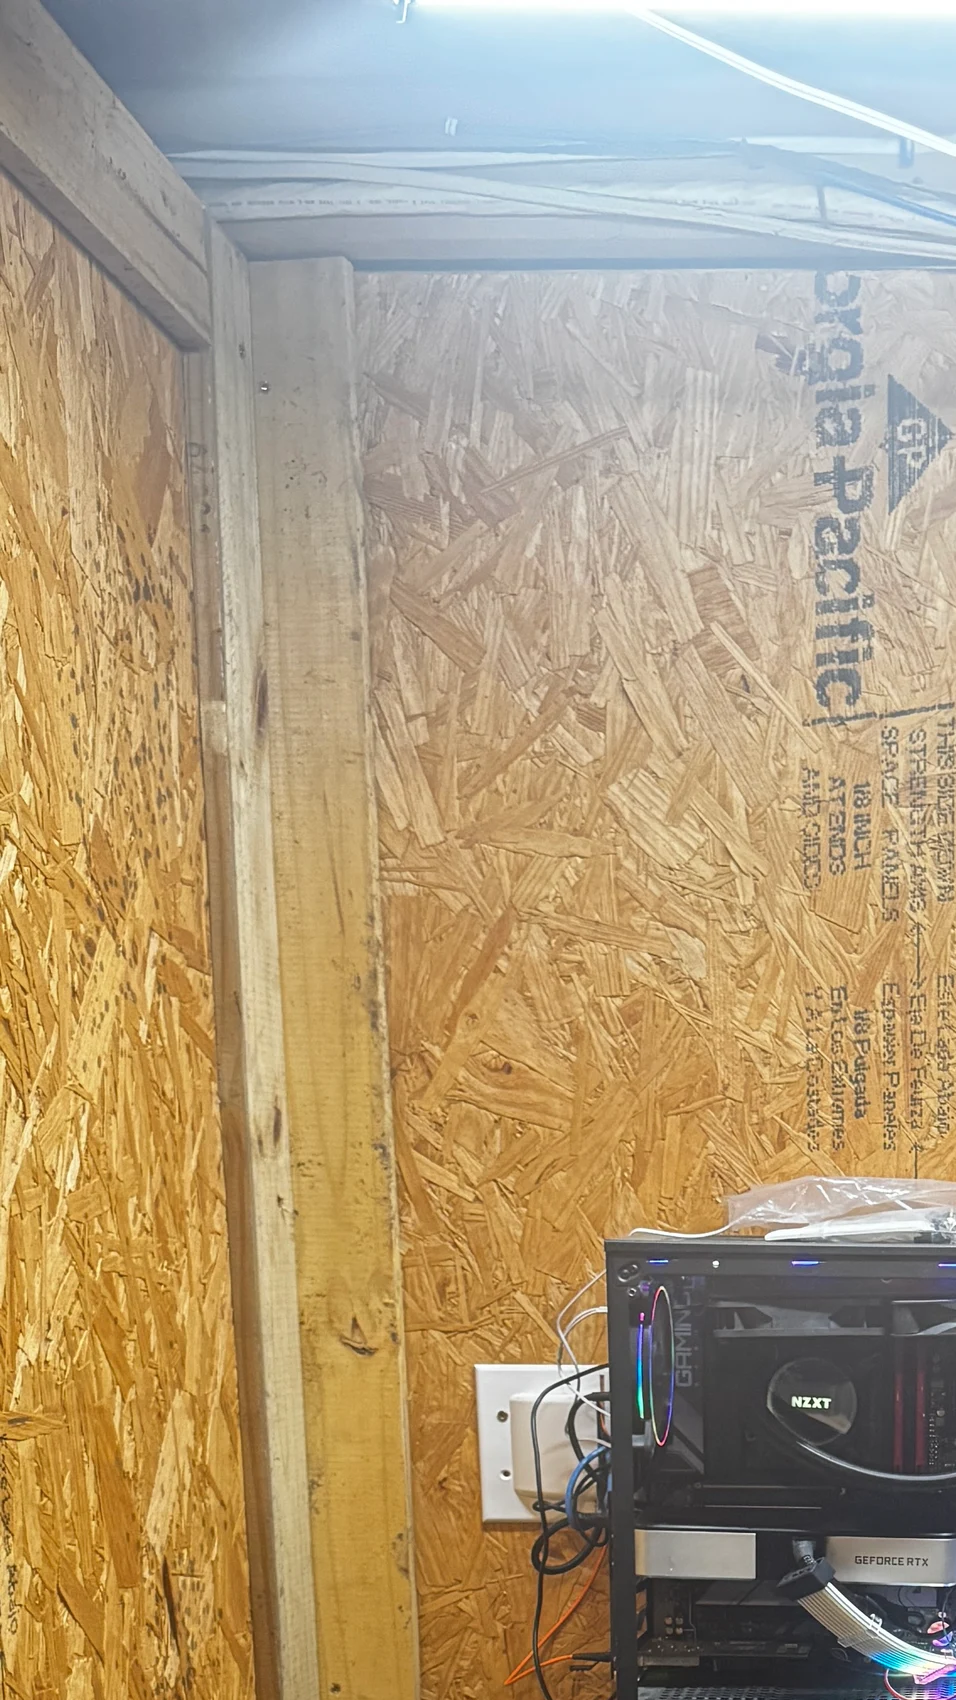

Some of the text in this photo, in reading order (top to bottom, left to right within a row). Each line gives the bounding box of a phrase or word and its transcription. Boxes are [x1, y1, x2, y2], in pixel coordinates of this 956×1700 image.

[896, 418, 928, 467] GP
[802, 767, 821, 890] AND SIDES
[828, 776, 846, 876] AT ENDS
[853, 781, 872, 871] 1/8 INCH
[881, 726, 900, 922] SPACE PANELS
[909, 728, 927, 913] STRENGTH AXIS
[937, 717, 956, 903] THIS SIDE DOWN
[830, 986, 848, 1014] En
[830, 1019, 848, 1055] Los
[937, 974, 955, 1021] Este
[849, 1009, 871, 1120] 1/8 Pulgada
[910, 1030, 927, 1060] De
[883, 1072, 901, 1151] Paneles
[791, 1396, 832, 1409] NZXT
[855, 1555, 929, 1567] GEFORCE RTX
